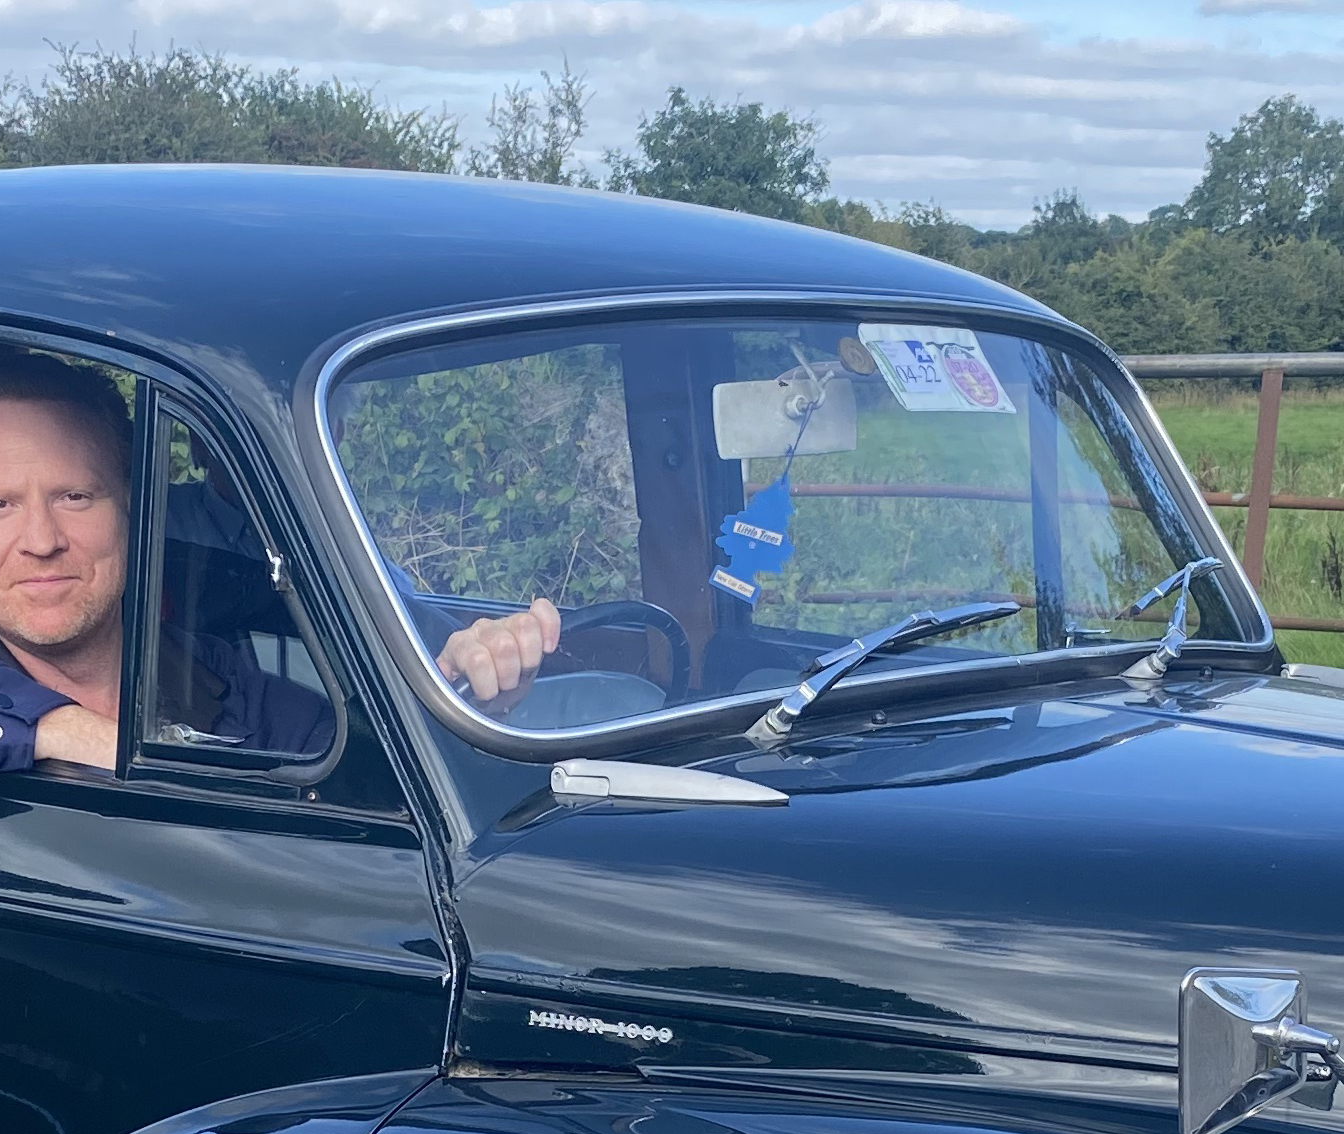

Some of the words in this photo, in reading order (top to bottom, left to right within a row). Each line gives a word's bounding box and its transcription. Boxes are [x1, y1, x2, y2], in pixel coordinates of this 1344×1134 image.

[895, 364, 941, 383] 04-22
[736, 524, 758, 538] Little
[760, 530, 780, 544] Trees
[528, 1010, 603, 1035] MINOR
[616, 1021, 673, 1043] 1000
